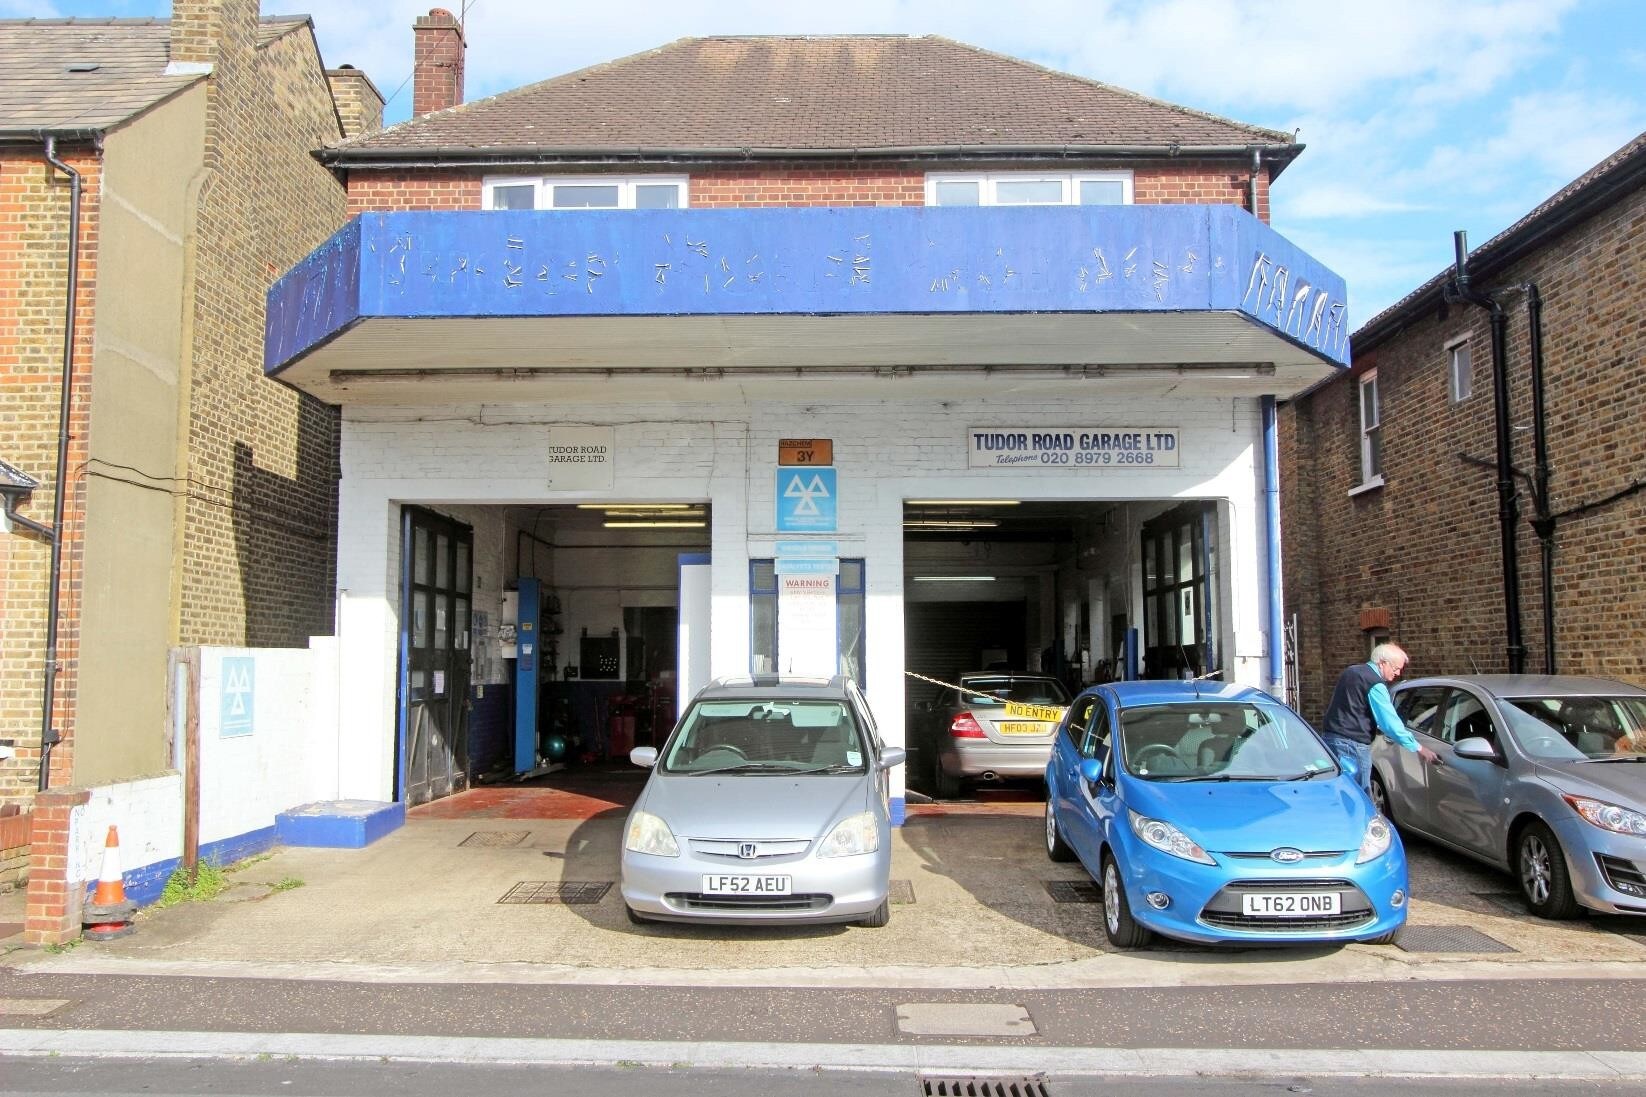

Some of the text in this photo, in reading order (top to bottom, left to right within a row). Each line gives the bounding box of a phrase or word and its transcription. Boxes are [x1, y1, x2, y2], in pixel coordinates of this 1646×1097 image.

[580, 445, 607, 453] ROAD
[974, 433, 1175, 451] TUDOR ROAD GARAGE LTD
[797, 450, 815, 462] 3Y
[995, 452, 1154, 465] Telephone 020 8979 2668
[785, 579, 830, 588] WARNING
[1010, 705, 1058, 720] NO ENTRY
[709, 876, 785, 892] LF52 AEU
[1250, 896, 1332, 912] LT62 ONB
